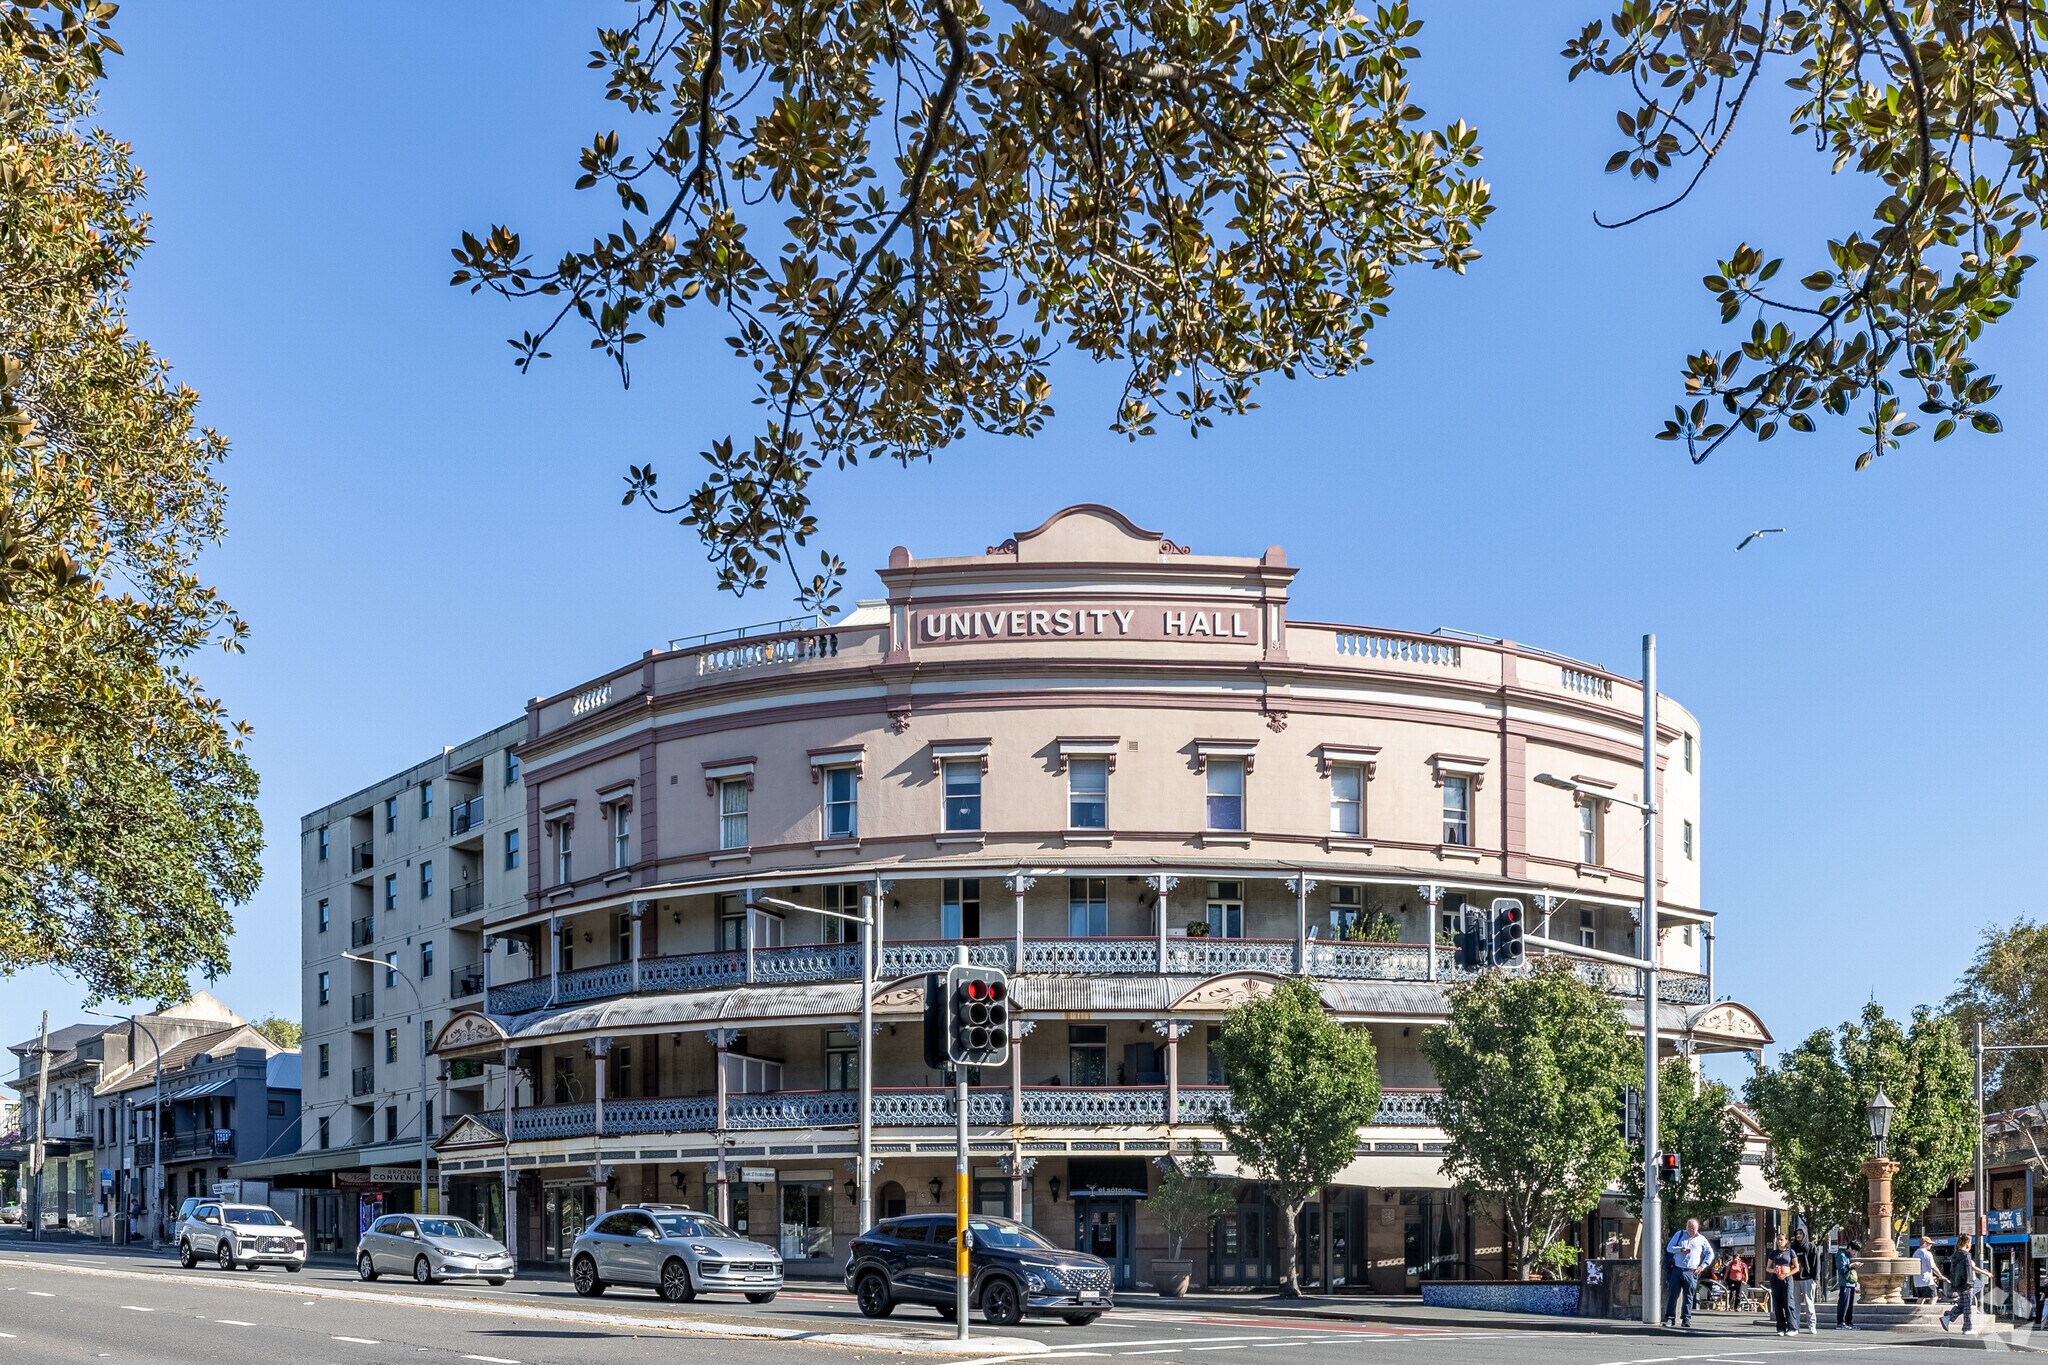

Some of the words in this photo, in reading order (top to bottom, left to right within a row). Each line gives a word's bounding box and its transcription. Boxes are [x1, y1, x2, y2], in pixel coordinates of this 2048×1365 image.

[924, 609, 1135, 638] UNIVERSITY
[1163, 610, 1249, 638] HALL
[373, 1174, 440, 1182] CONVENIECE
